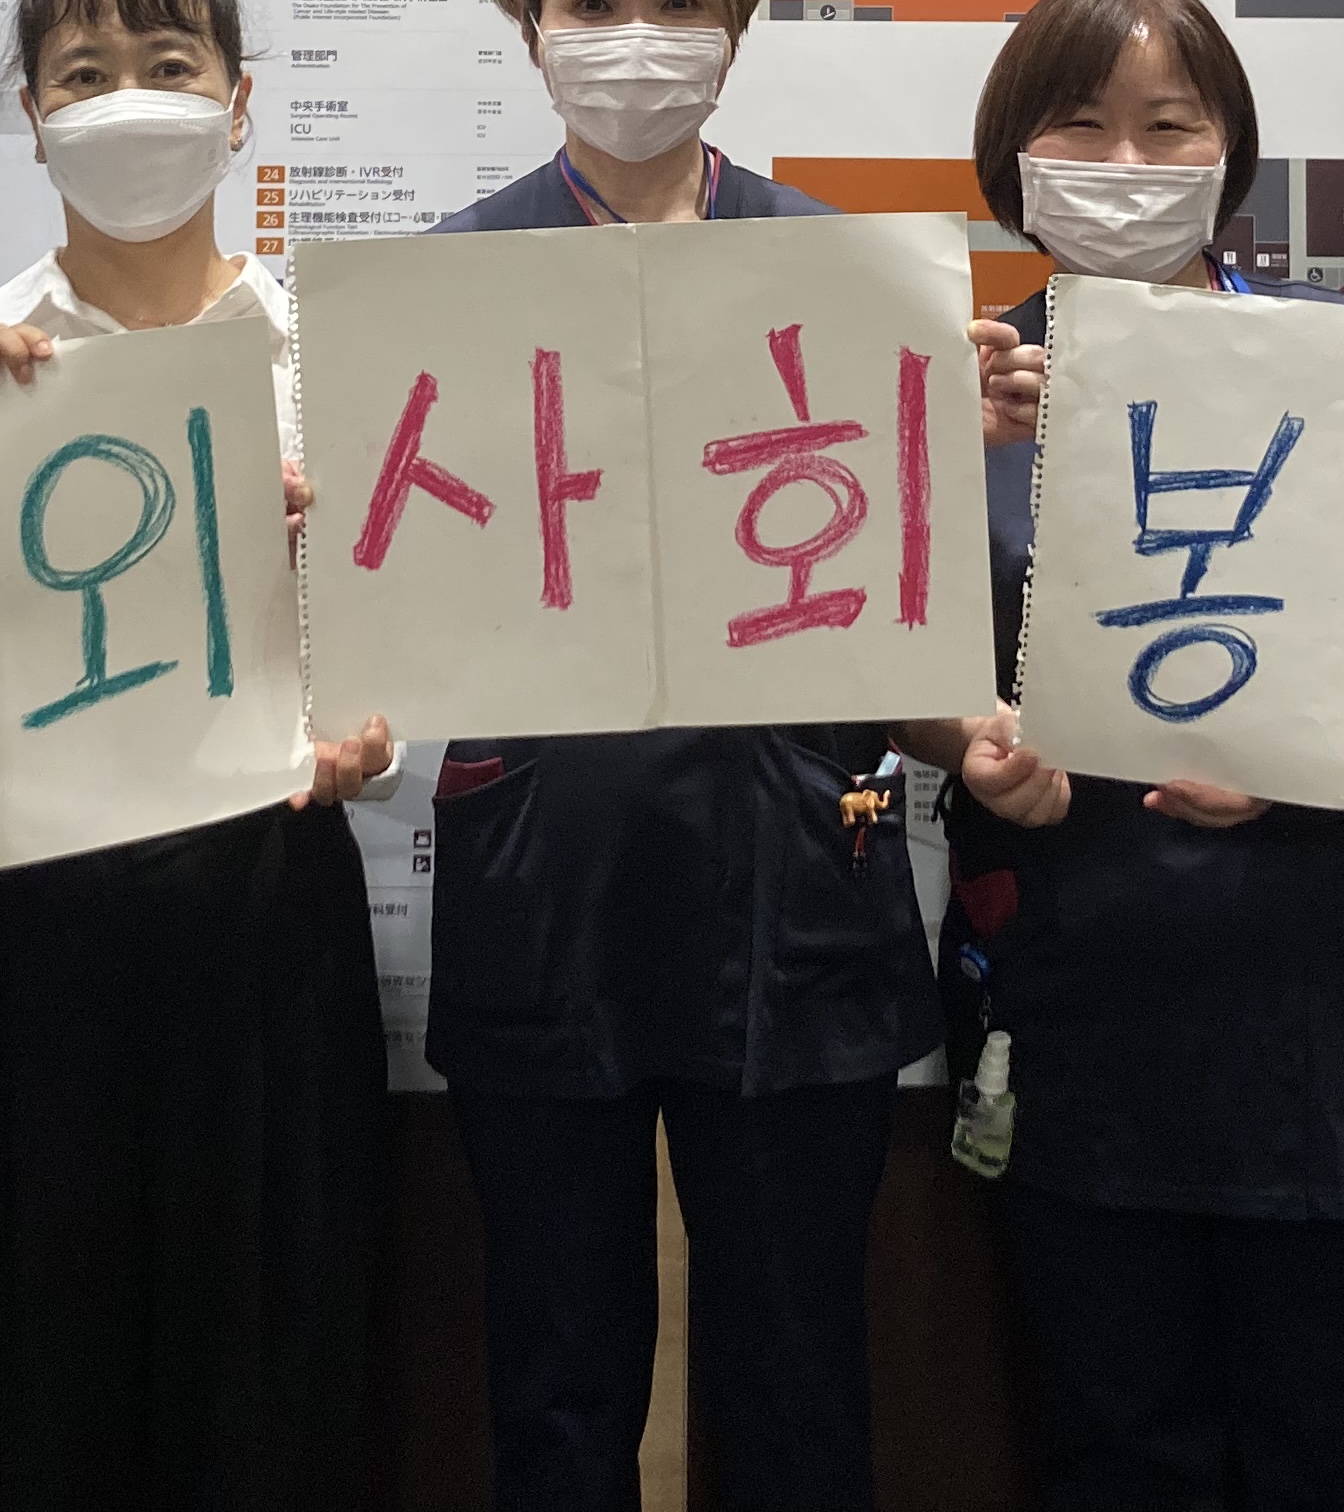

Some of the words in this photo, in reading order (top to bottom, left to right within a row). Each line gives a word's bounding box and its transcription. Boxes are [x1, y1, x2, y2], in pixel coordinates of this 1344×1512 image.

[291, 49, 338, 62] 管理部門
[290, 100, 349, 113] 中央手術室
[290, 123, 313, 135] ICU
[262, 168, 280, 181] 24
[262, 190, 280, 204] 25
[288, 188, 416, 202] リハビリテーション受付
[261, 213, 279, 227] 26
[261, 239, 279, 253] 27
